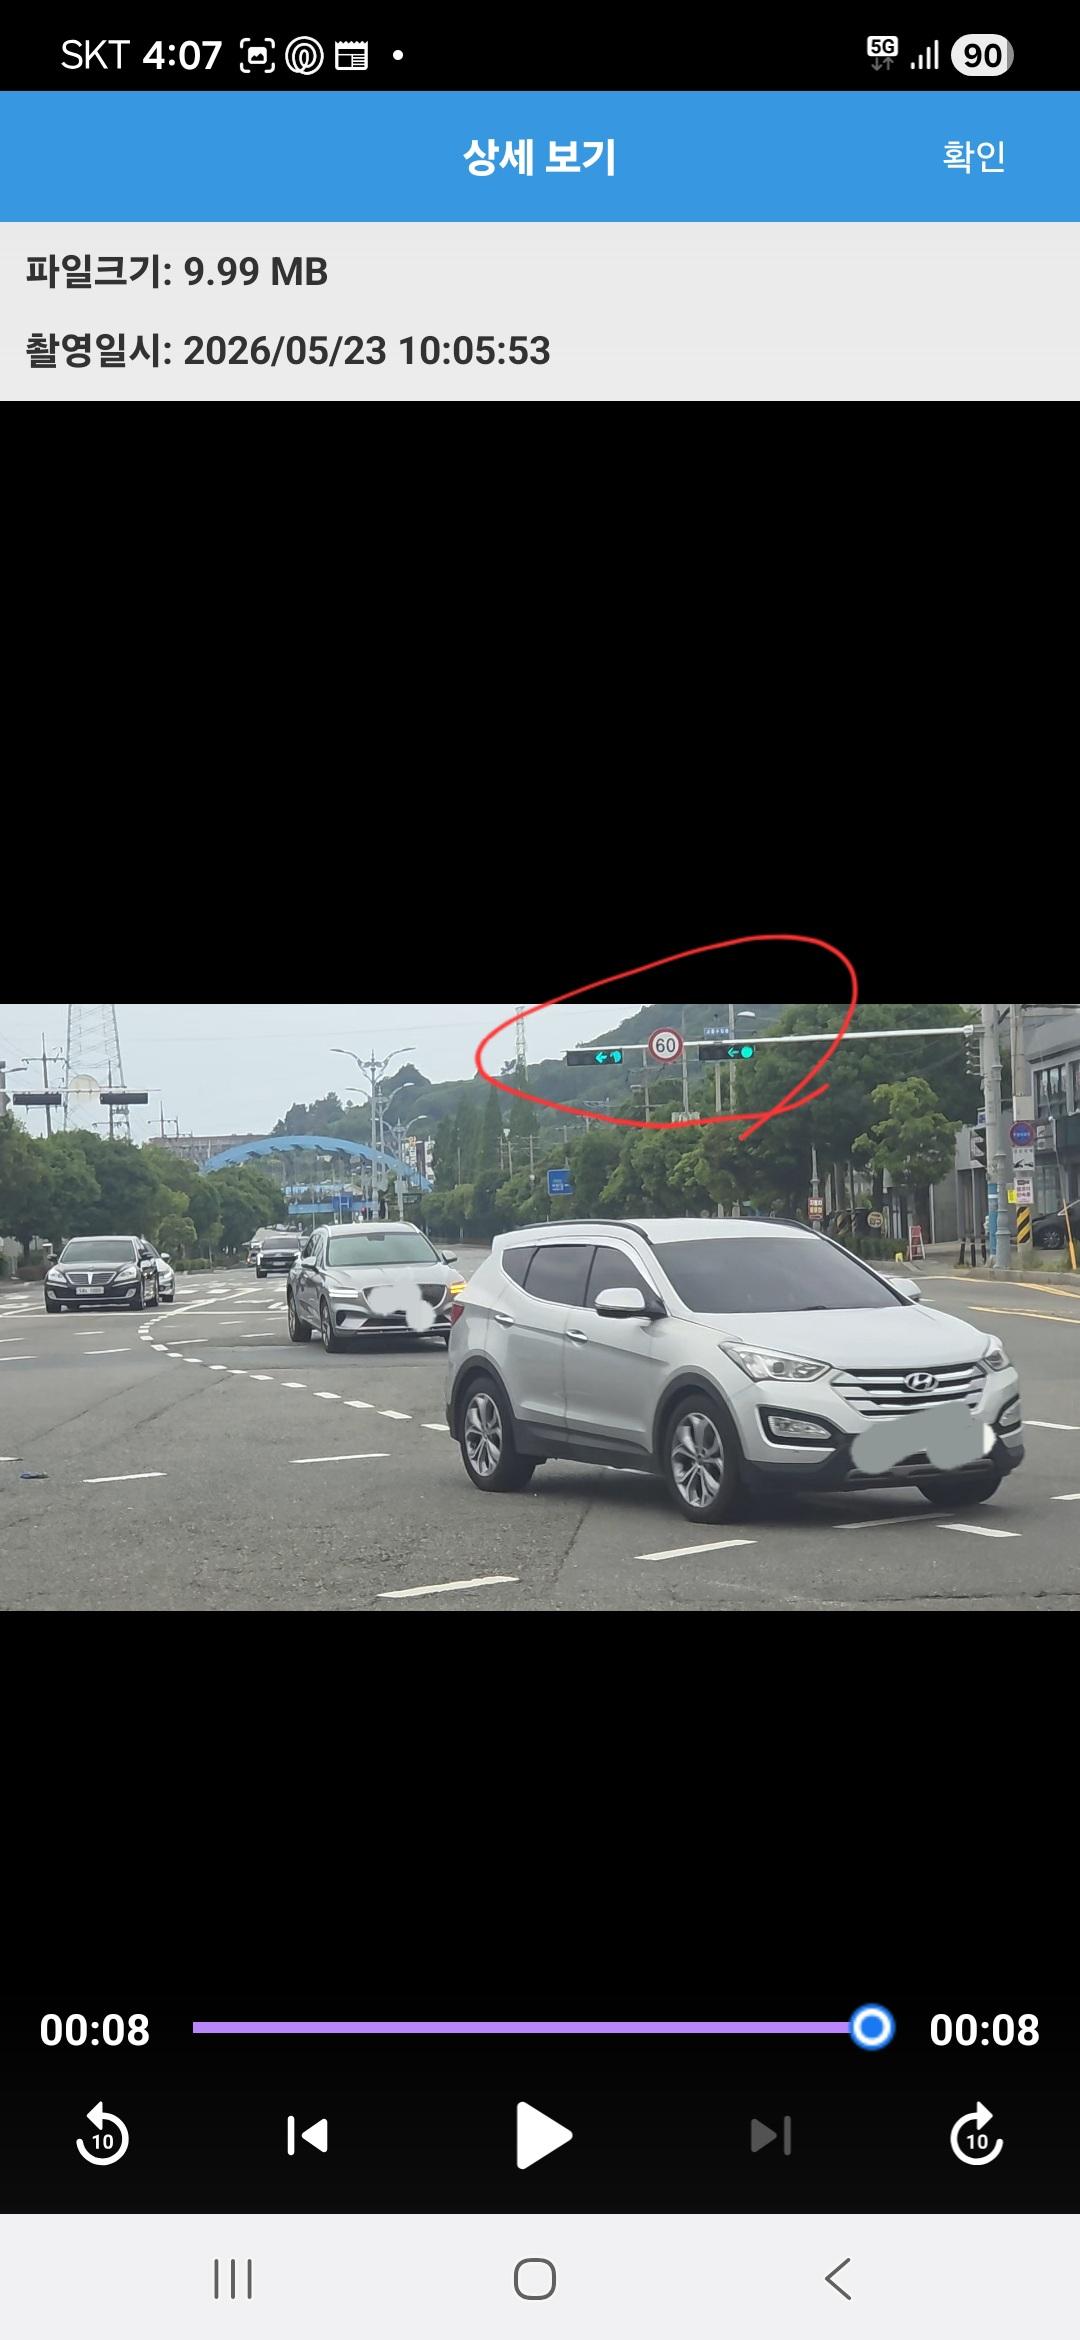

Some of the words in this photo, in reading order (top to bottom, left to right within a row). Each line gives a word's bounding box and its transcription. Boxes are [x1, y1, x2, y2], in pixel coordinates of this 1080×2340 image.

[60, 39, 131, 70] SKT
[142, 39, 223, 70] 4:07
[871, 38, 895, 54] 5G
[964, 43, 1002, 68] 90
[463, 138, 534, 177] 상세
[545, 138, 615, 177] 보기
[943, 140, 1005, 175] 확인
[26, 253, 172, 290] 파일크기:
[184, 256, 259, 286] 9.99
[271, 256, 328, 286] MB
[25, 332, 172, 369] 촬영일시:
[183, 335, 387, 368] 2026/05/23
[399, 335, 551, 366] 10:05:53
[655, 1038, 676, 1053] 60
[40, 2013, 150, 2047] 00:08
[930, 2013, 1040, 2047] 00:08
[92, 2133, 114, 2150] 10
[966, 2133, 989, 2150] 10
